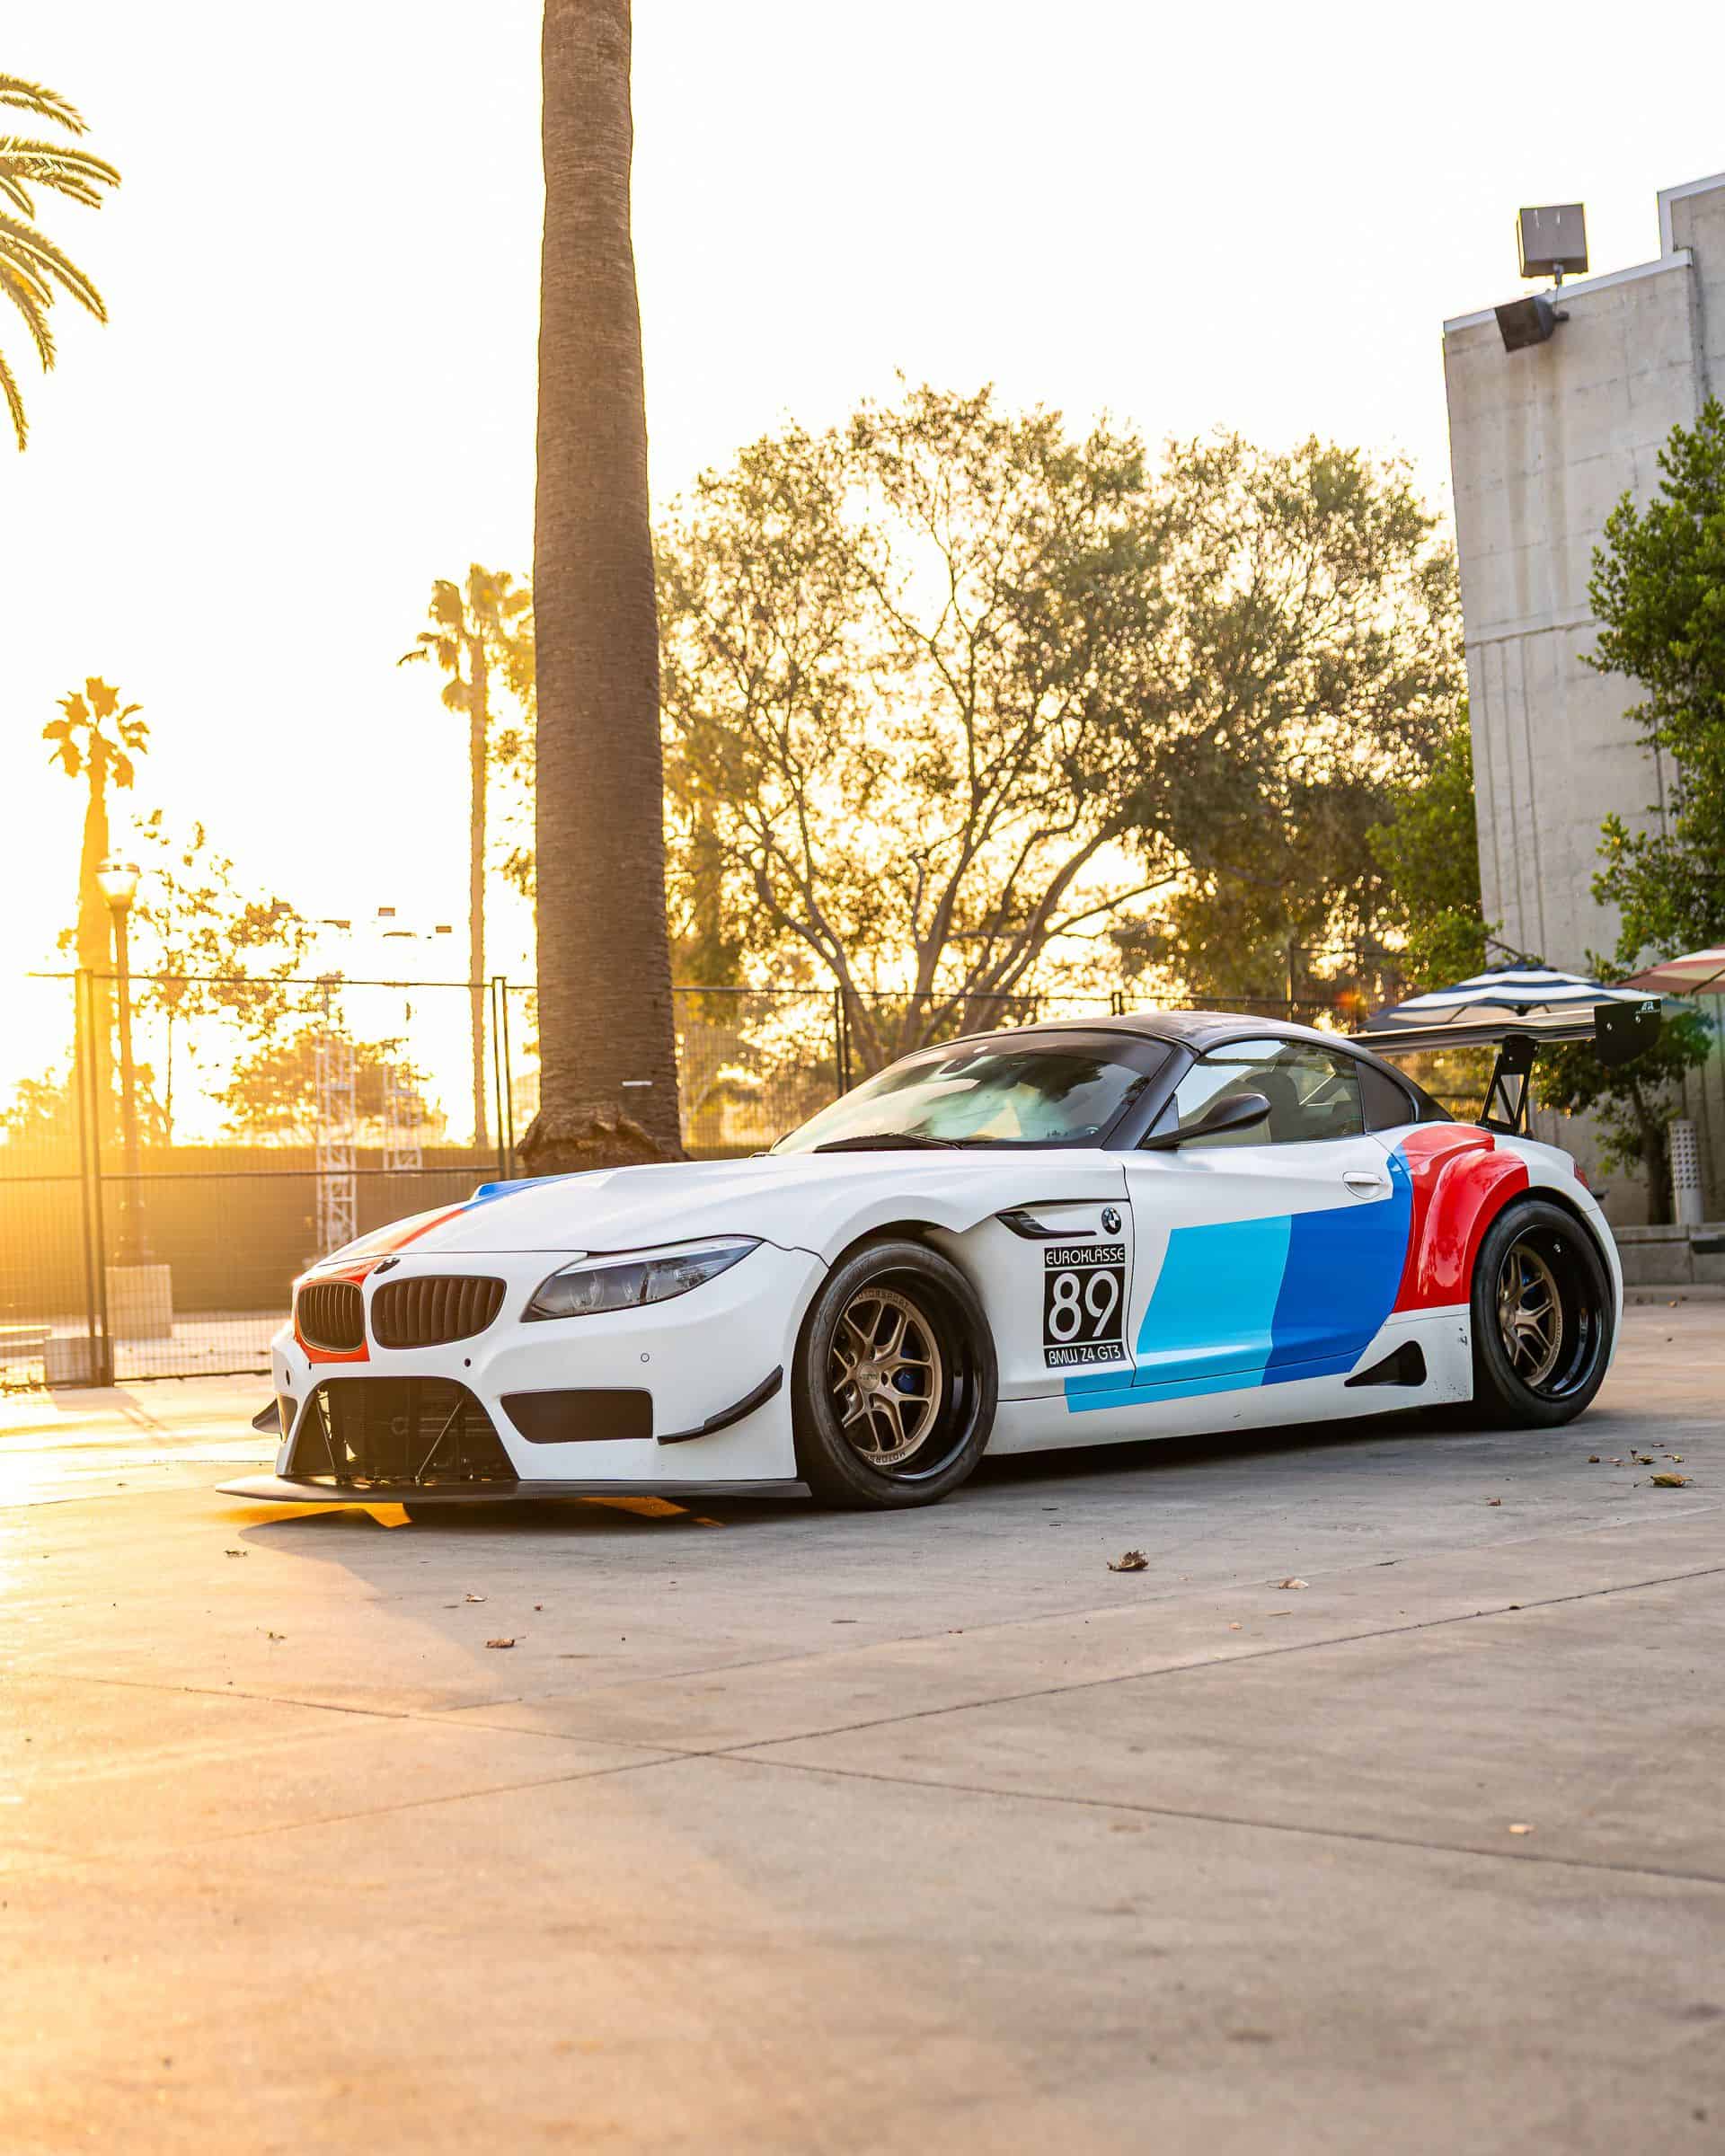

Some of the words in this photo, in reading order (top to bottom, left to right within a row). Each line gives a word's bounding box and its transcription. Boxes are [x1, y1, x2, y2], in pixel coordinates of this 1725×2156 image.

[1048, 1269, 1119, 1341] 89
[1048, 1348, 1078, 1365] BMW
[1080, 1348, 1095, 1362] Z4
[1097, 1345, 1121, 1360] GT3
